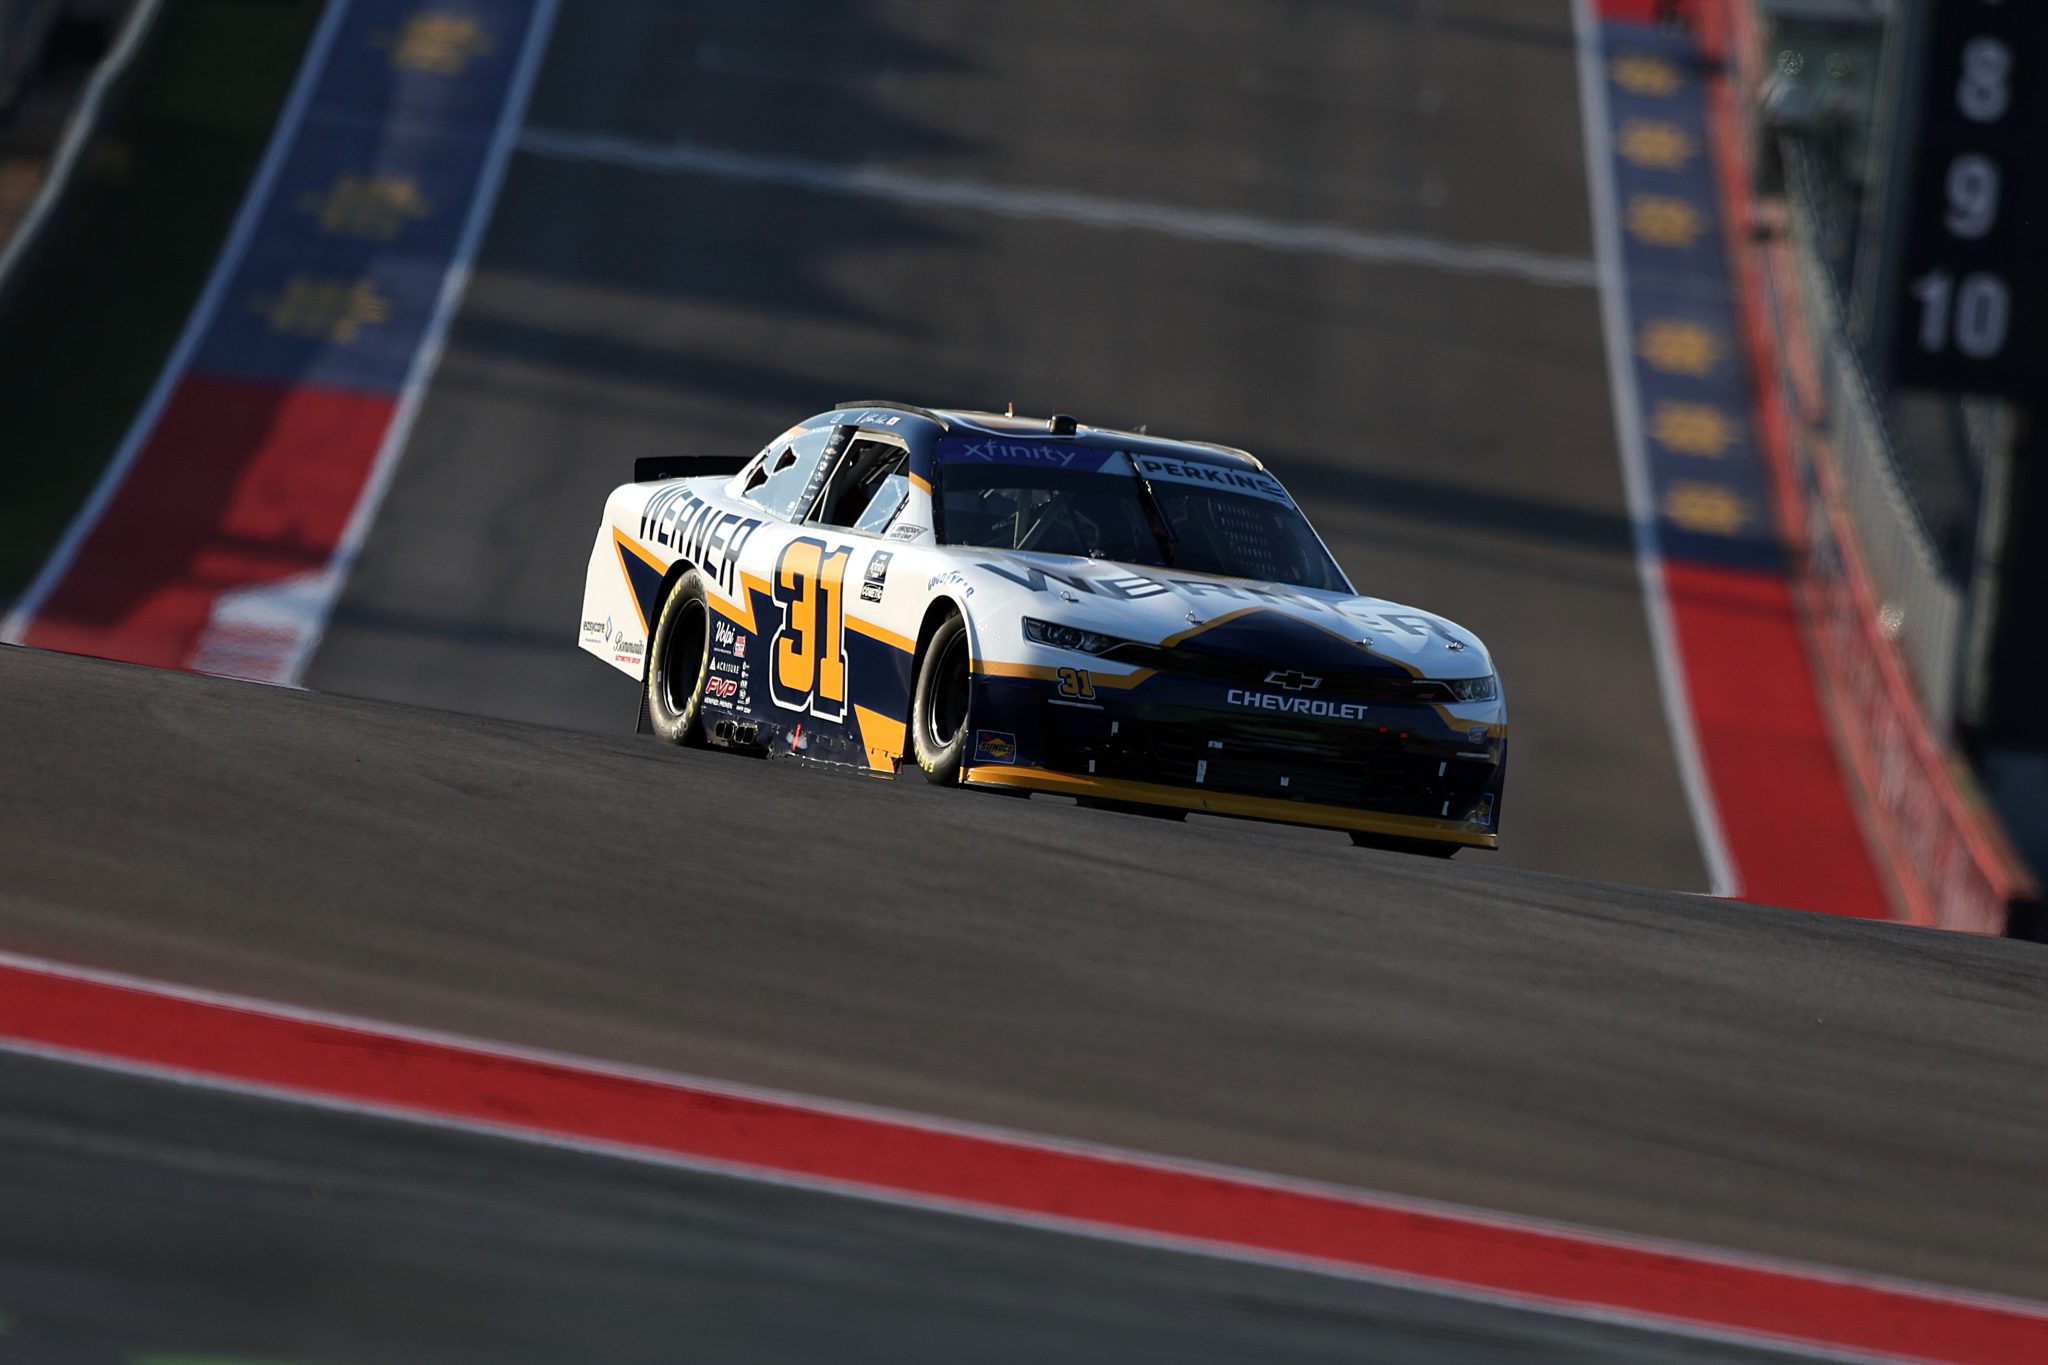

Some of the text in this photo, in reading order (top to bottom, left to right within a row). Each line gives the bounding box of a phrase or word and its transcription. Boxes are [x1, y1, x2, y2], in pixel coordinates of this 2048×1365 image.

[1957, 36, 2011, 123] 8
[1945, 153, 1999, 240] 9
[1911, 266, 2010, 360] 10
[963, 439, 1077, 467] xfinity
[1141, 458, 1285, 499] PERKINS
[639, 482, 762, 598] WERNER
[772, 537, 853, 722] 31
[705, 676, 738, 698] FVP
[1056, 666, 1097, 700] 31
[1226, 689, 1368, 720] CHEVROLET
